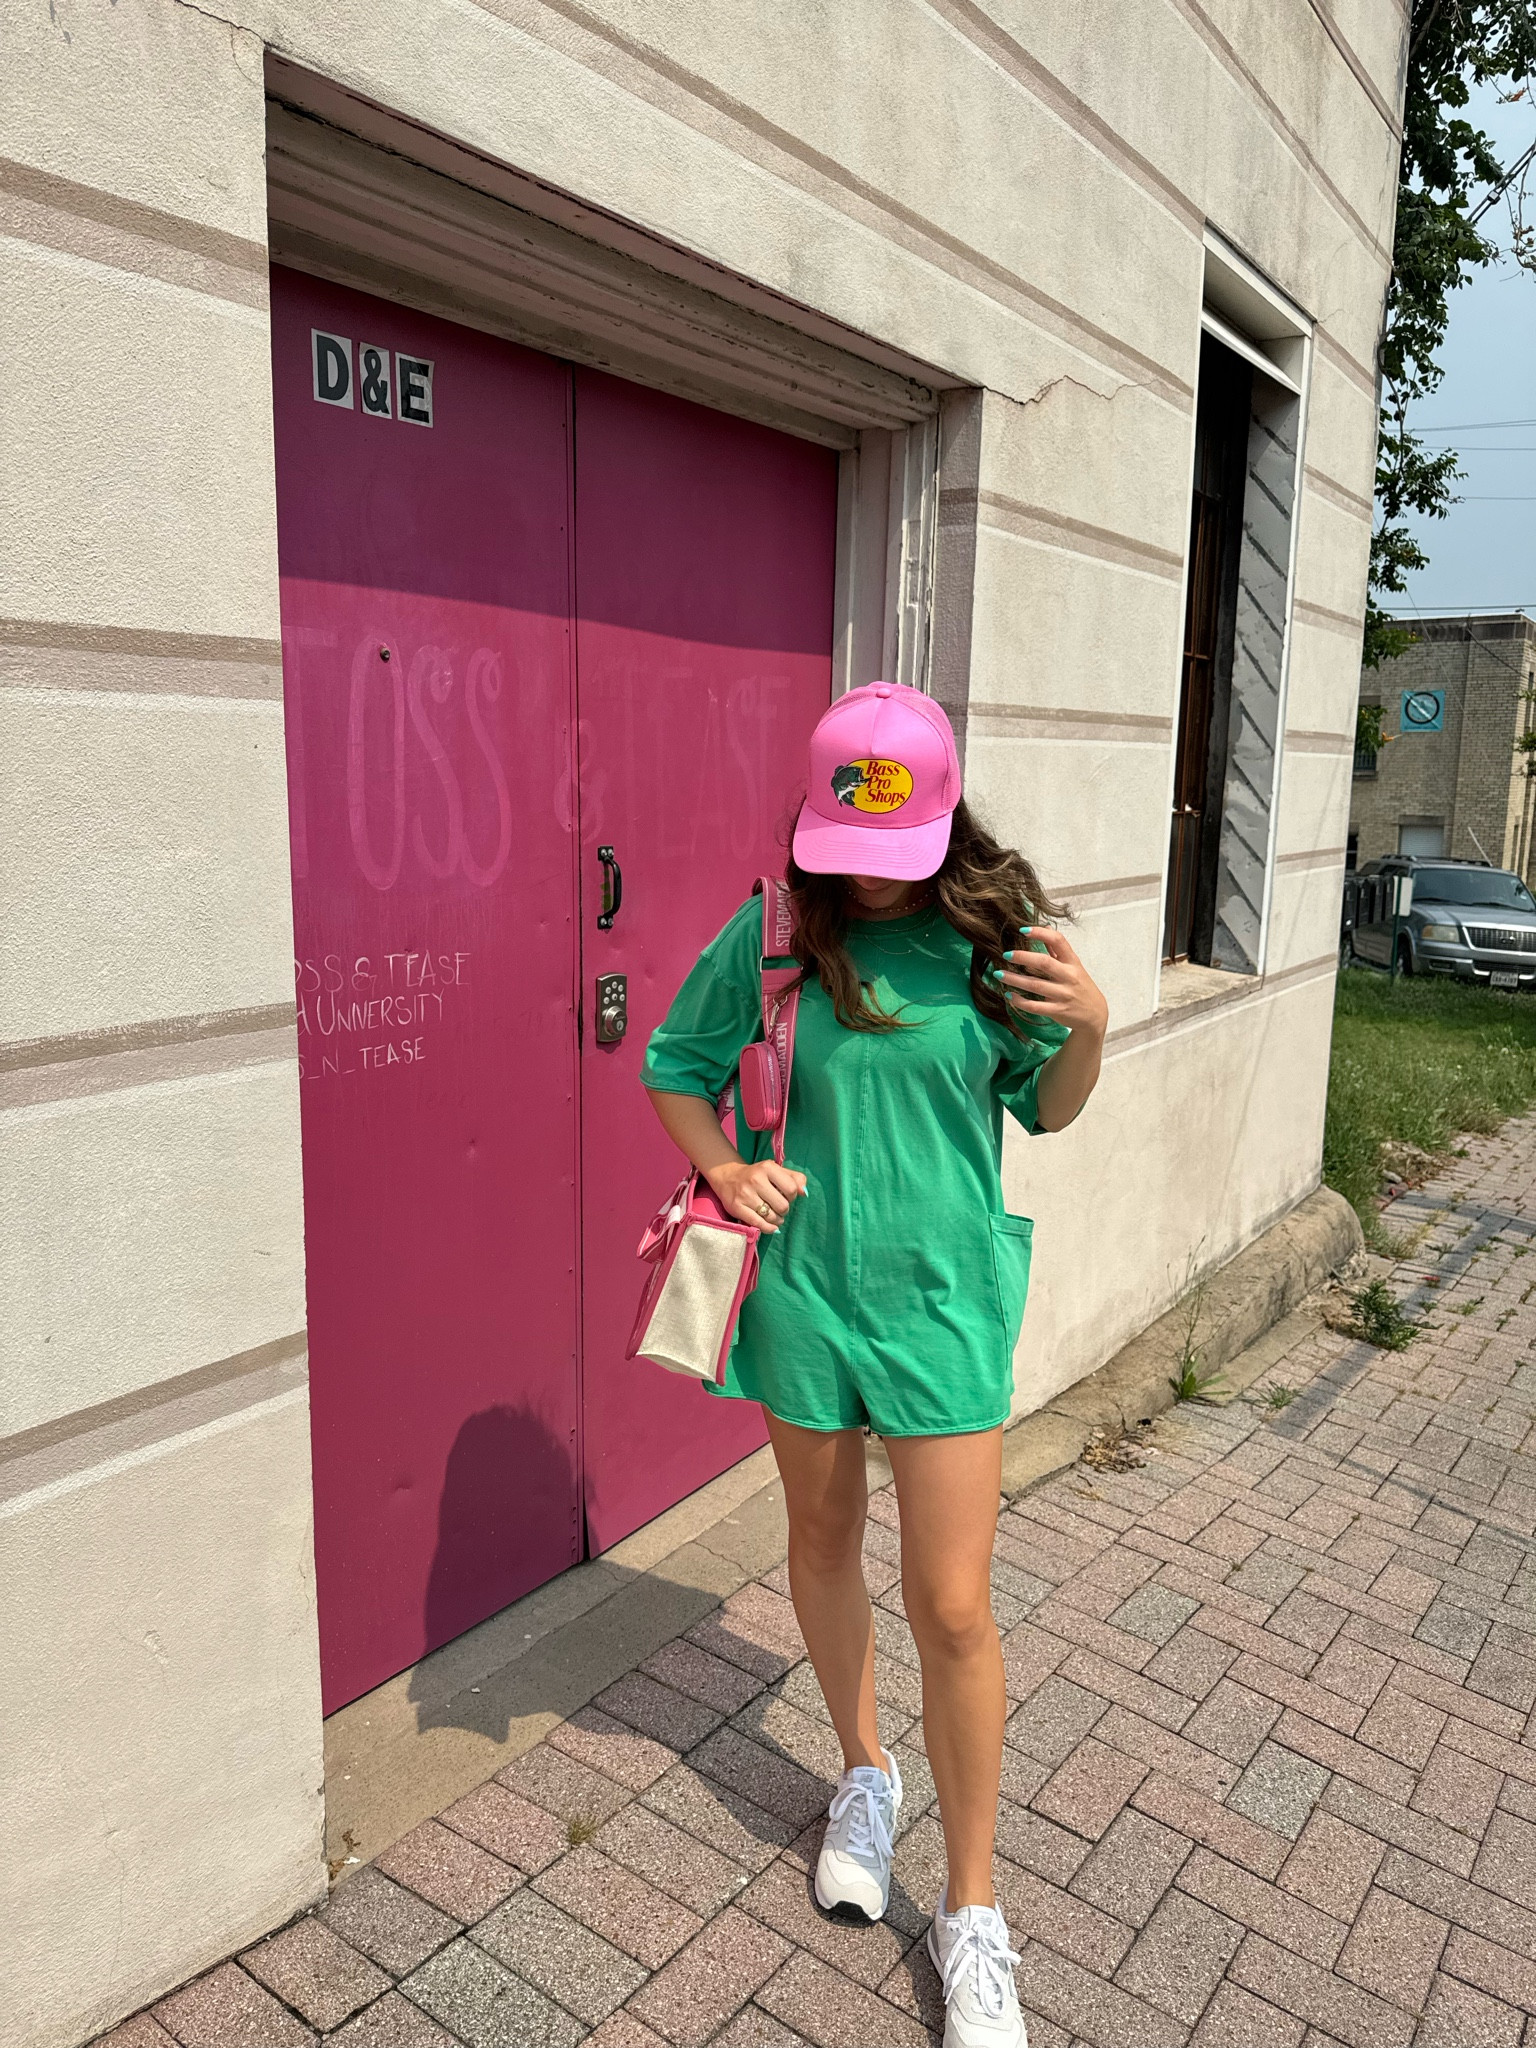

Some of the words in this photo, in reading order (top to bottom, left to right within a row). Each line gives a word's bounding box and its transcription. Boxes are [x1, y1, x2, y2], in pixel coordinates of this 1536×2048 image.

[316, 334, 430, 423] D&E
[866, 761, 900, 776] Bass
[867, 776, 891, 789] Pro
[865, 789, 906, 806] Shops
[352, 956, 377, 997] &
[384, 949, 471, 988] TEASE
[317, 988, 444, 1035] UNIVERSITY
